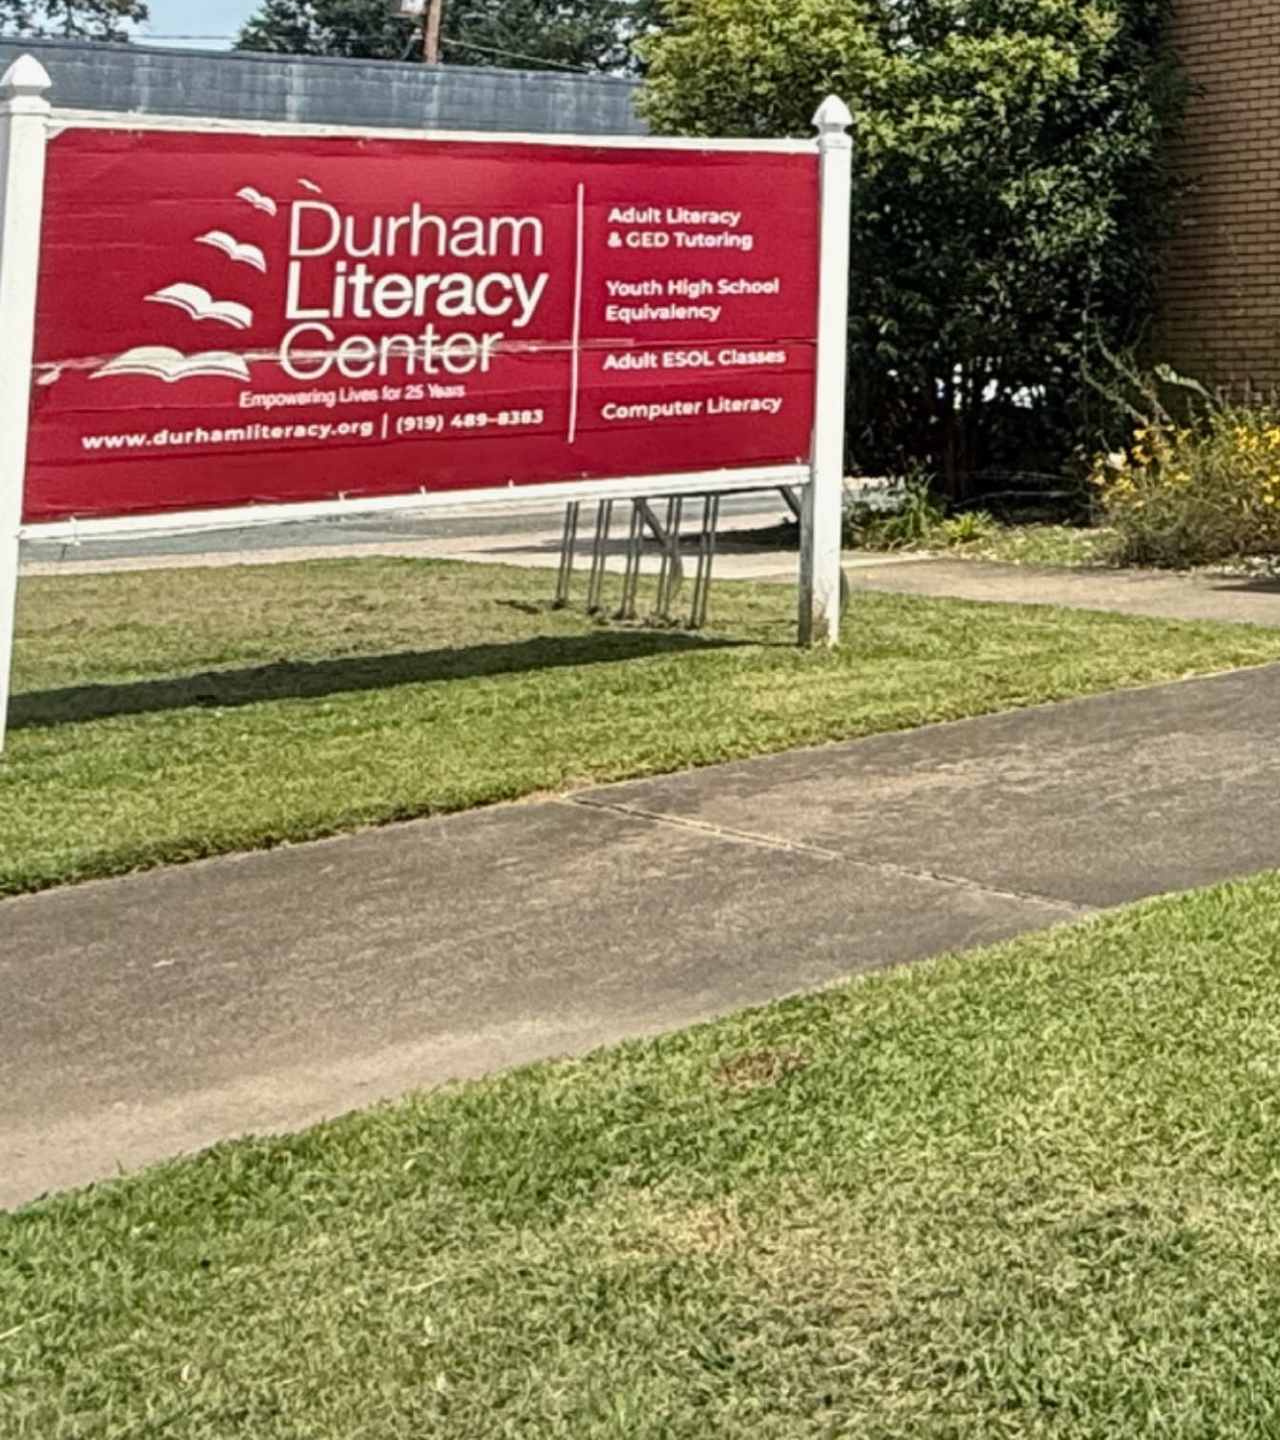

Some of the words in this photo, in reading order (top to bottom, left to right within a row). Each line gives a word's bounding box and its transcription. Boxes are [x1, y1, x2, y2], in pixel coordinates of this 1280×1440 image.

[290, 200, 543, 257] Durham
[608, 208, 661, 224] Adult
[666, 208, 741, 227] Literacy
[607, 231, 622, 248] &
[626, 232, 669, 248] GED
[673, 231, 754, 251] Tutoring
[285, 261, 549, 327] Literacy
[606, 280, 662, 297] Youth
[668, 278, 713, 299] High
[717, 278, 780, 295] School
[605, 303, 721, 324] Equivalency
[280, 322, 504, 380] Center
[603, 353, 658, 371] Adult
[662, 351, 715, 368] ESOL
[718, 348, 787, 366] Classes
[239, 389, 336, 410] Empowering
[339, 387, 378, 404] Lives
[382, 387, 401, 401] for
[405, 385, 424, 400] 25
[428, 383, 465, 399] Years
[601, 399, 702, 421] Computer
[706, 396, 783, 415] Literacy
[82, 420, 374, 449] www.durhamliteracy.org
[396, 414, 444, 435] (919)
